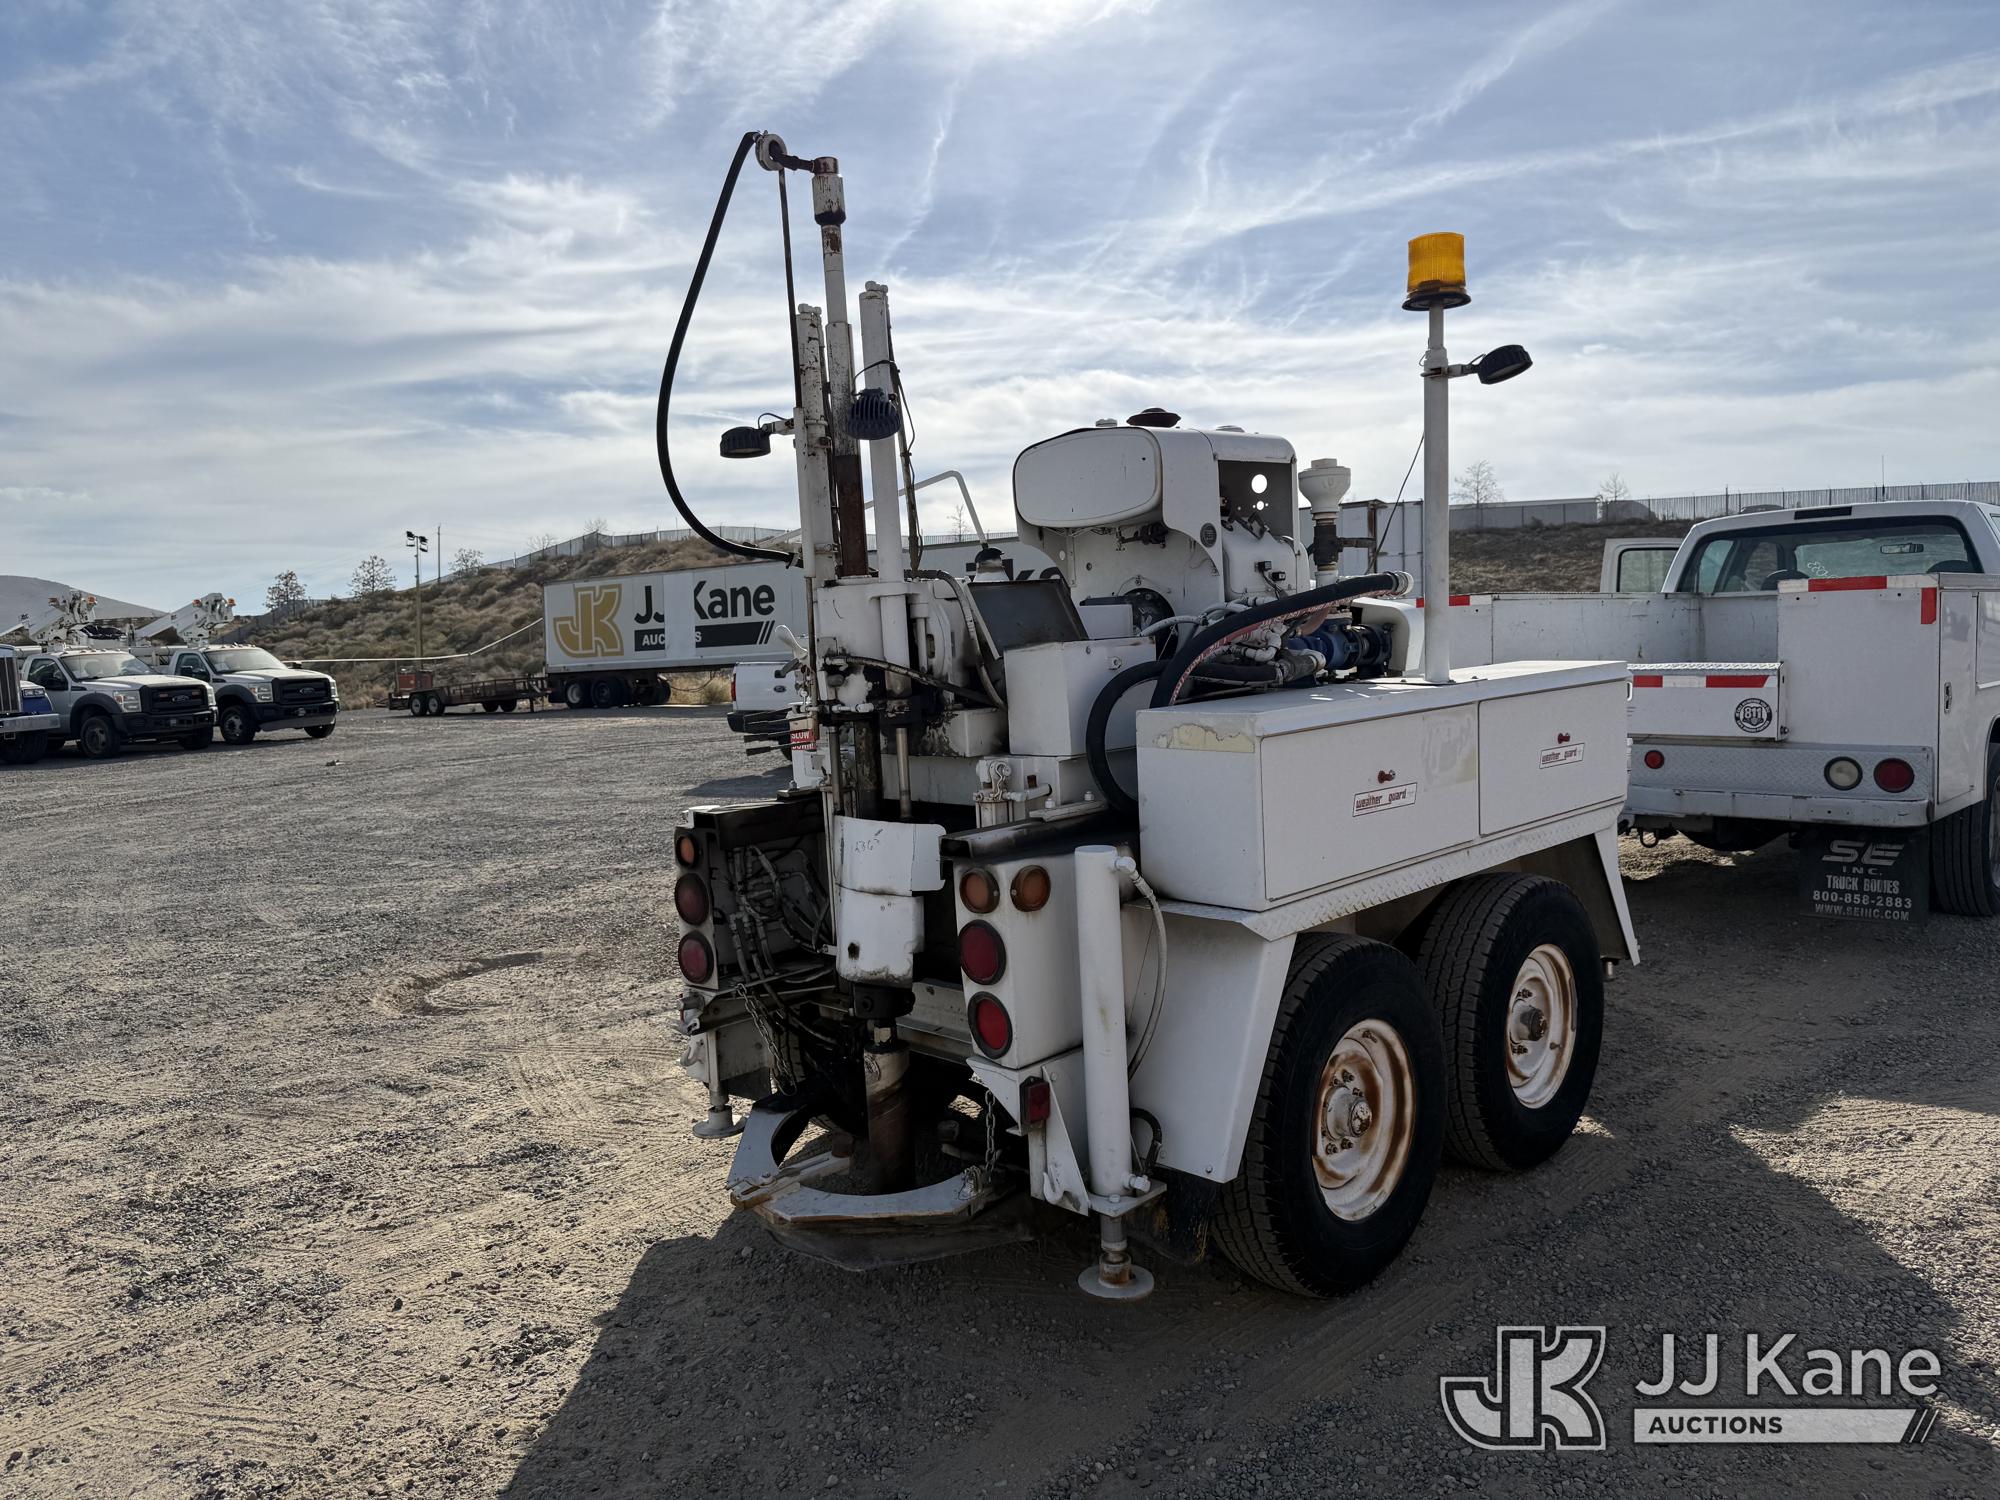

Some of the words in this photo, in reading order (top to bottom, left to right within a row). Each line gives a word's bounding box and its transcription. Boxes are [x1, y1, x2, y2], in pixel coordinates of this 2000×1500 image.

[1744, 706, 1763, 719] 811
[791, 731, 810, 739] SLOW
[1389, 788, 1407, 804] guard
[1842, 866, 1883, 876] INC.
[1826, 875, 1859, 891] TRUCK
[1863, 878, 1900, 894] BODIES
[1812, 890, 1913, 909] 800-858-2883
